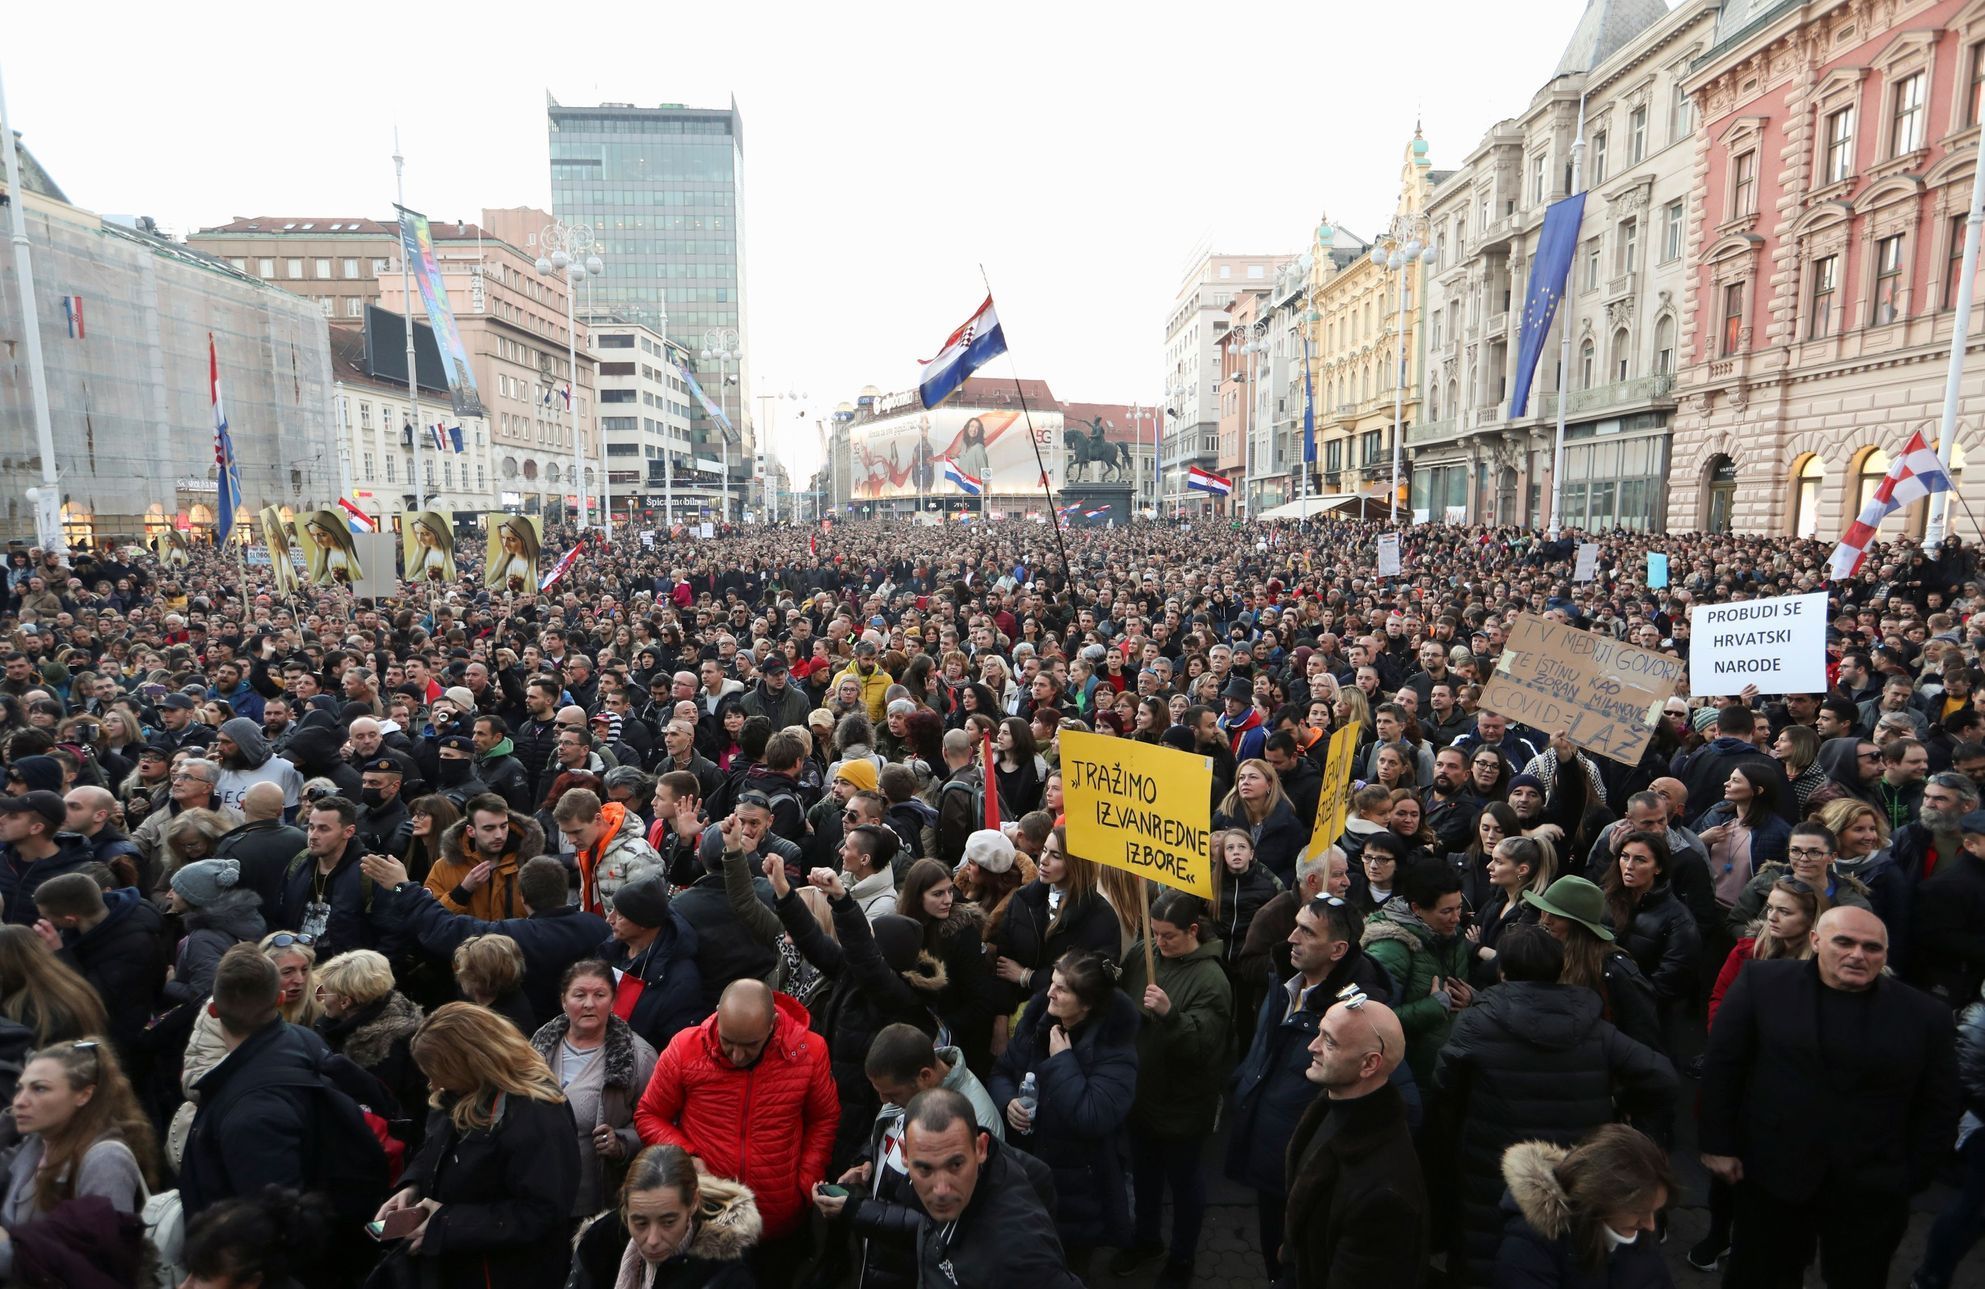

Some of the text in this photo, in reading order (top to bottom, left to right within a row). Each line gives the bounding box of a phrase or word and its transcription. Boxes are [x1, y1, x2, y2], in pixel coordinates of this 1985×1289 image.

[1036, 429, 1051, 444] 5G
[1707, 602, 1802, 623] PROBUDI SE
[1713, 629, 1791, 647] HRVATSKI
[1524, 618, 1680, 682] TV MEDIJI GOVORI
[1714, 658, 1781, 674] NARODE
[1531, 672, 1580, 698] ZORAN
[1589, 676, 1621, 696] KAO
[1490, 686, 1560, 724] COVID
[1567, 711, 1644, 761] LAŽ
[1096, 800, 1209, 857] IZVANREDNE
